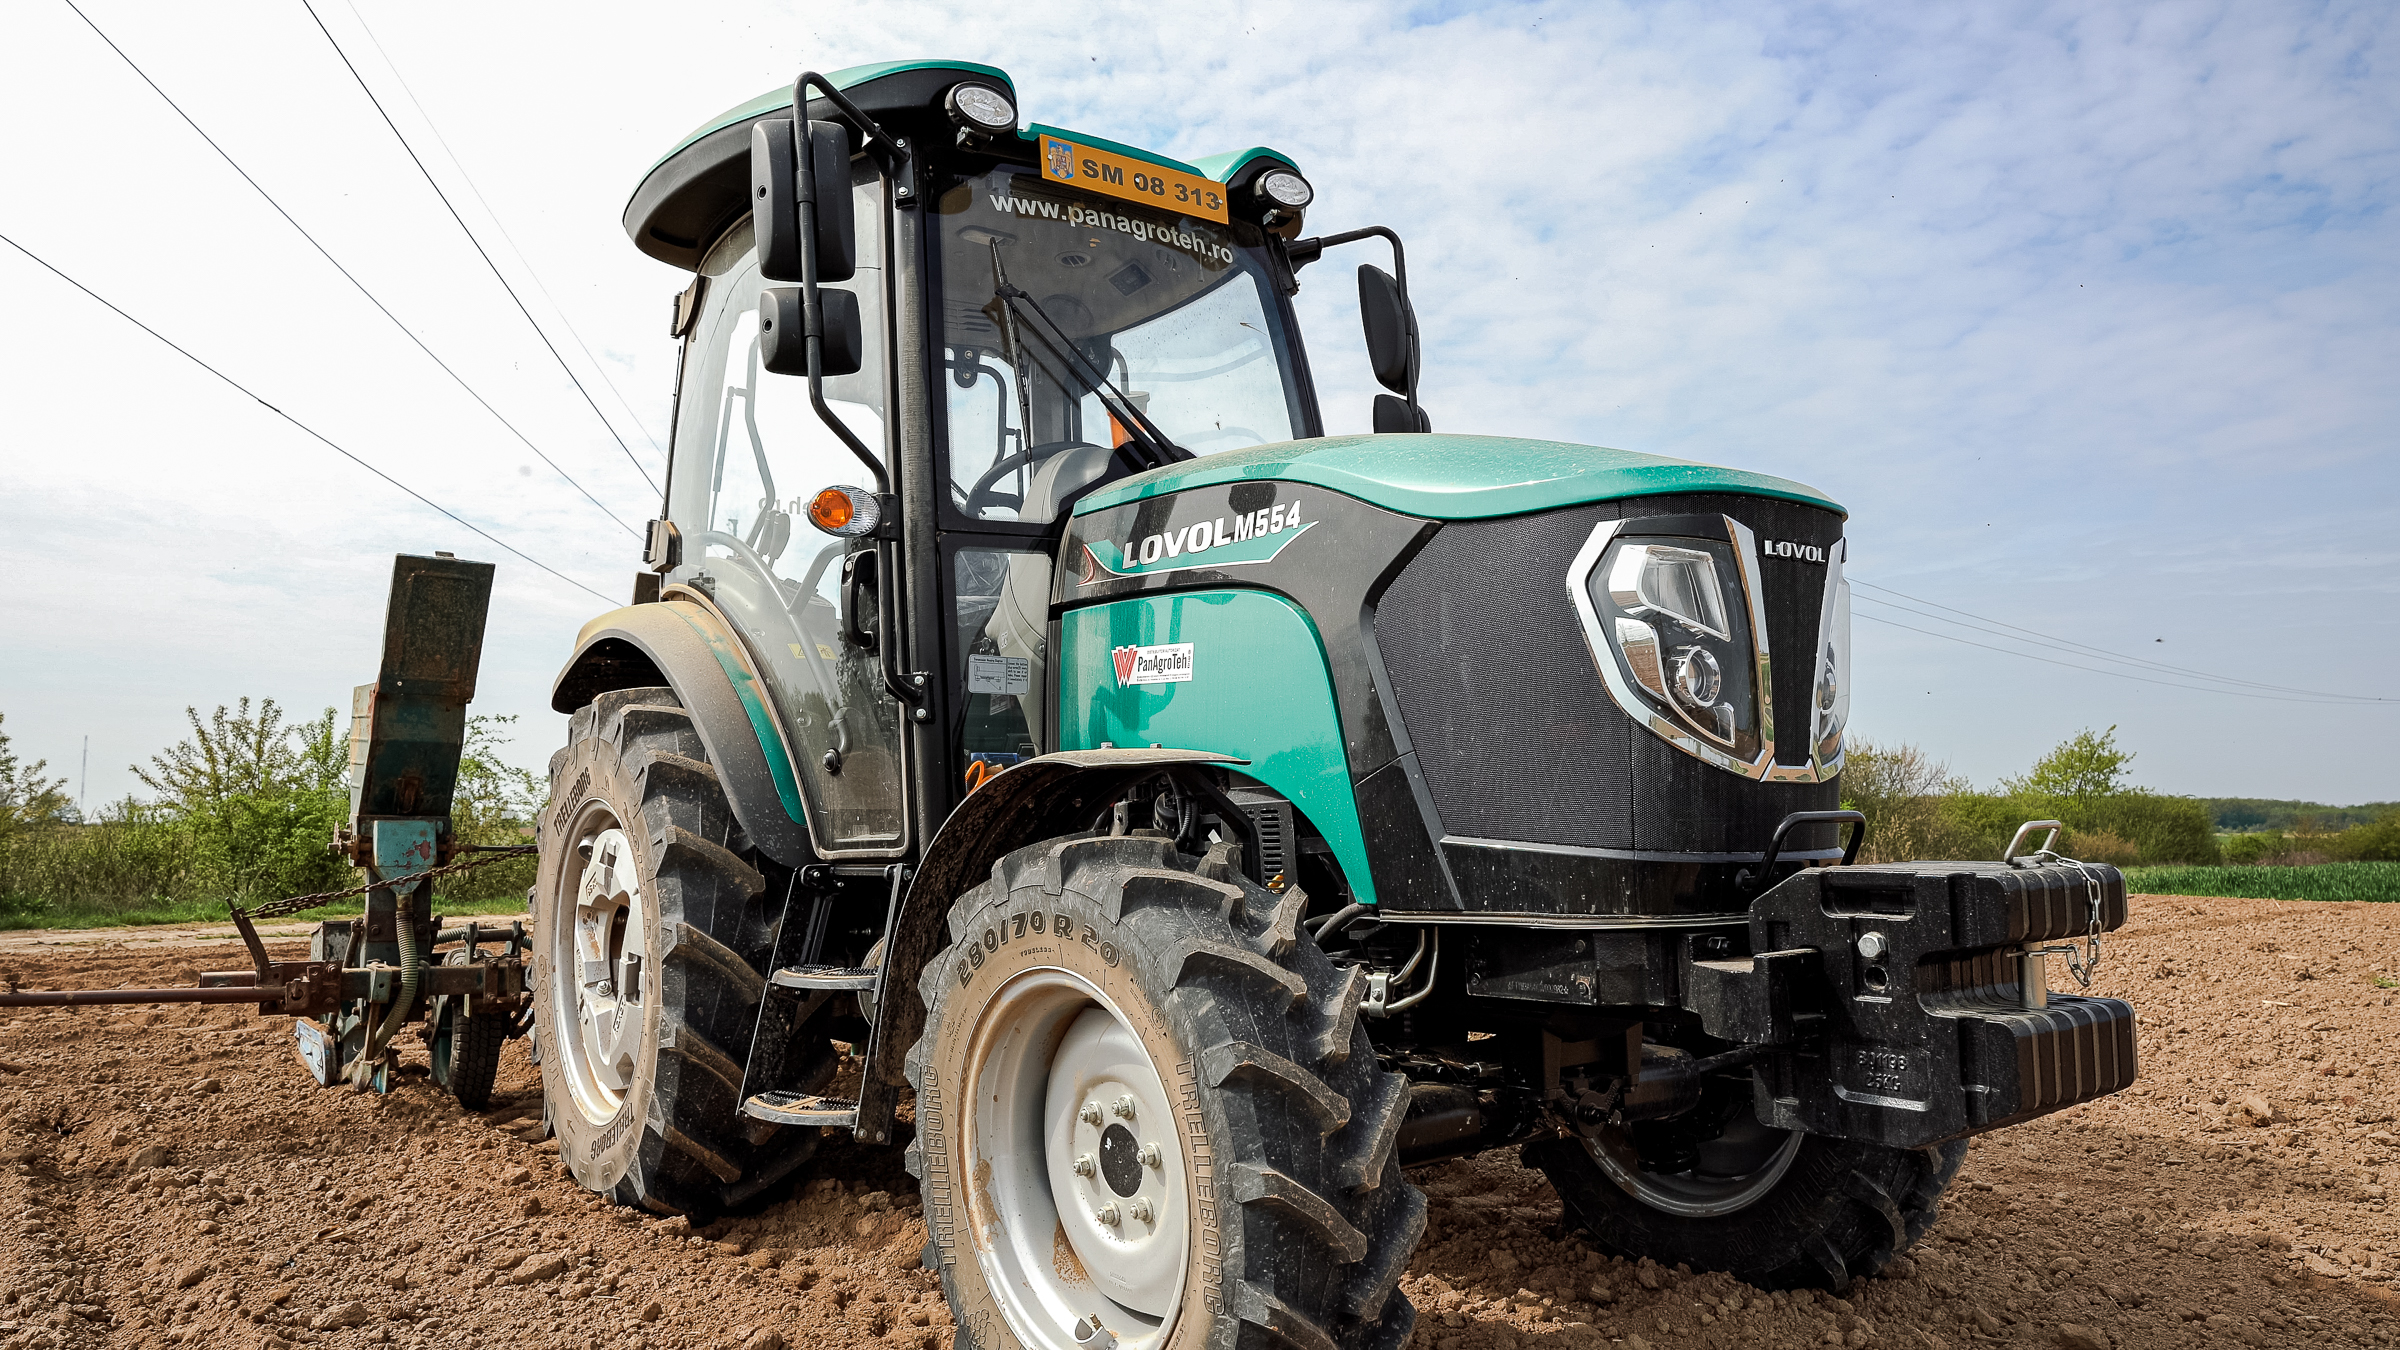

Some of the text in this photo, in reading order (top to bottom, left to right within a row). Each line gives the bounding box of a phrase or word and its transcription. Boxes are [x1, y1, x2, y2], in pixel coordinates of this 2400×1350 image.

[1082, 159, 1221, 211] SM 08 313
[990, 194, 1234, 264] www.panagroteh.ro
[1122, 499, 1301, 569] LOVOL M554
[1764, 539, 1826, 563] LOVOL
[1137, 653, 1187, 674] PanAgroTeh
[553, 766, 592, 837] TRELLEBORG
[957, 910, 1120, 989] 280/70 R 20
[590, 1102, 636, 1161] TRELLEBORG
[923, 1064, 956, 1270] TRELLEBORG
[1176, 1052, 1226, 1316] TRELLEBORG
